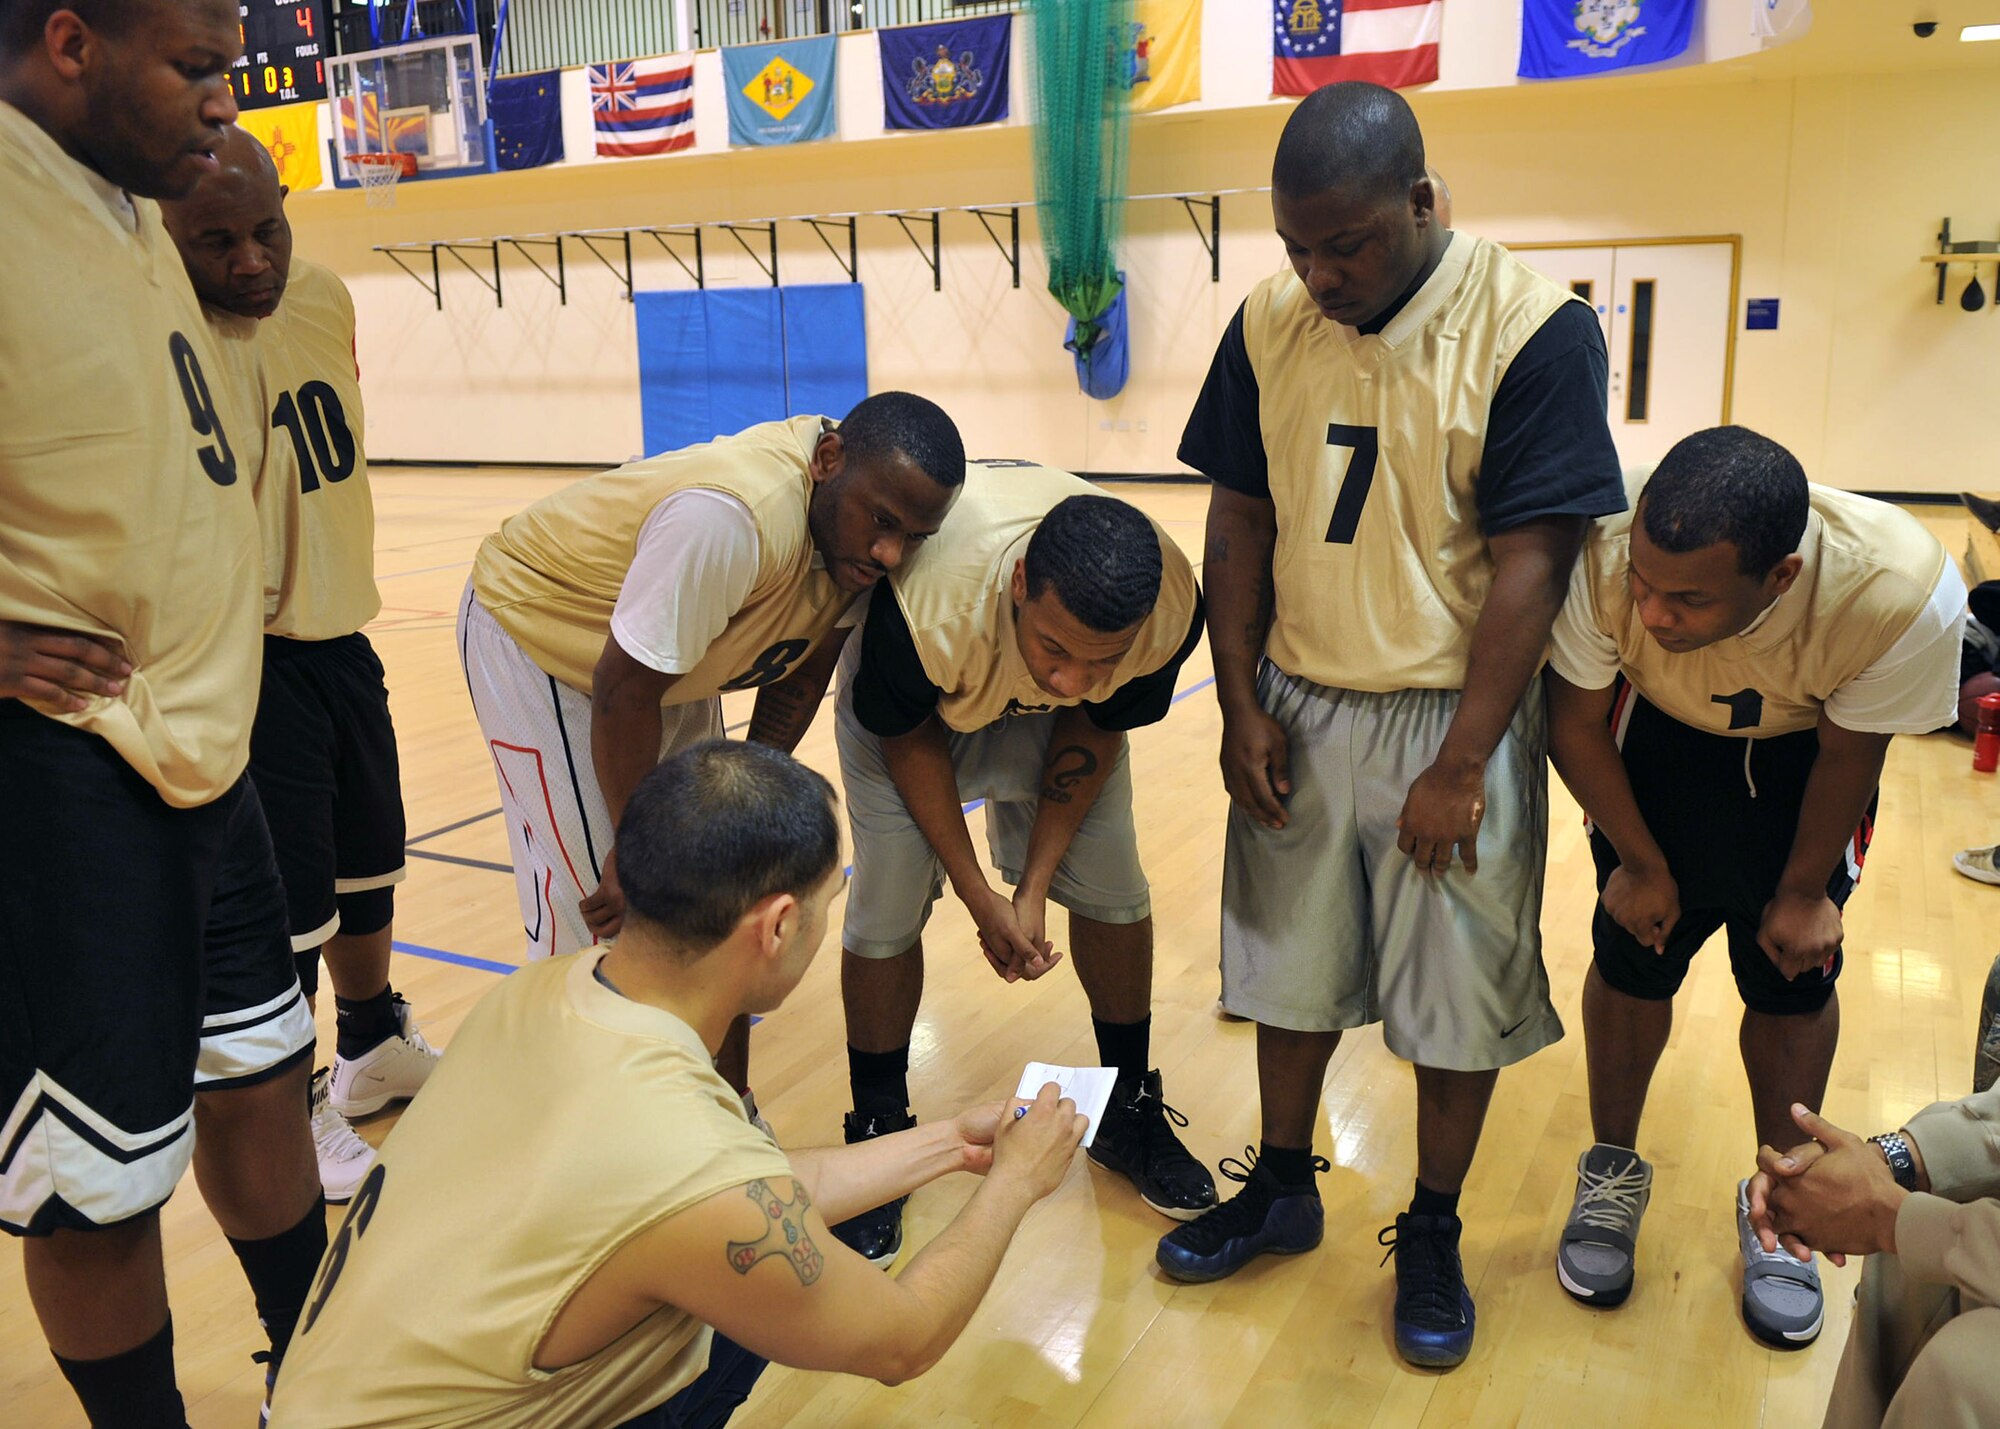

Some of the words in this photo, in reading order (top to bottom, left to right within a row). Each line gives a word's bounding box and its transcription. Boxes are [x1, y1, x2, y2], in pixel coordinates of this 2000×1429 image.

[296, 8, 313, 37] 4
[257, 52, 268, 64] PTS
[296, 43, 319, 58] FOULS
[243, 73, 250, 95] 1
[316, 61, 323, 83] 1
[169, 331, 236, 486] 9
[272, 380, 355, 494] 10
[1325, 423, 1378, 544] 7
[718, 639, 810, 691] 8
